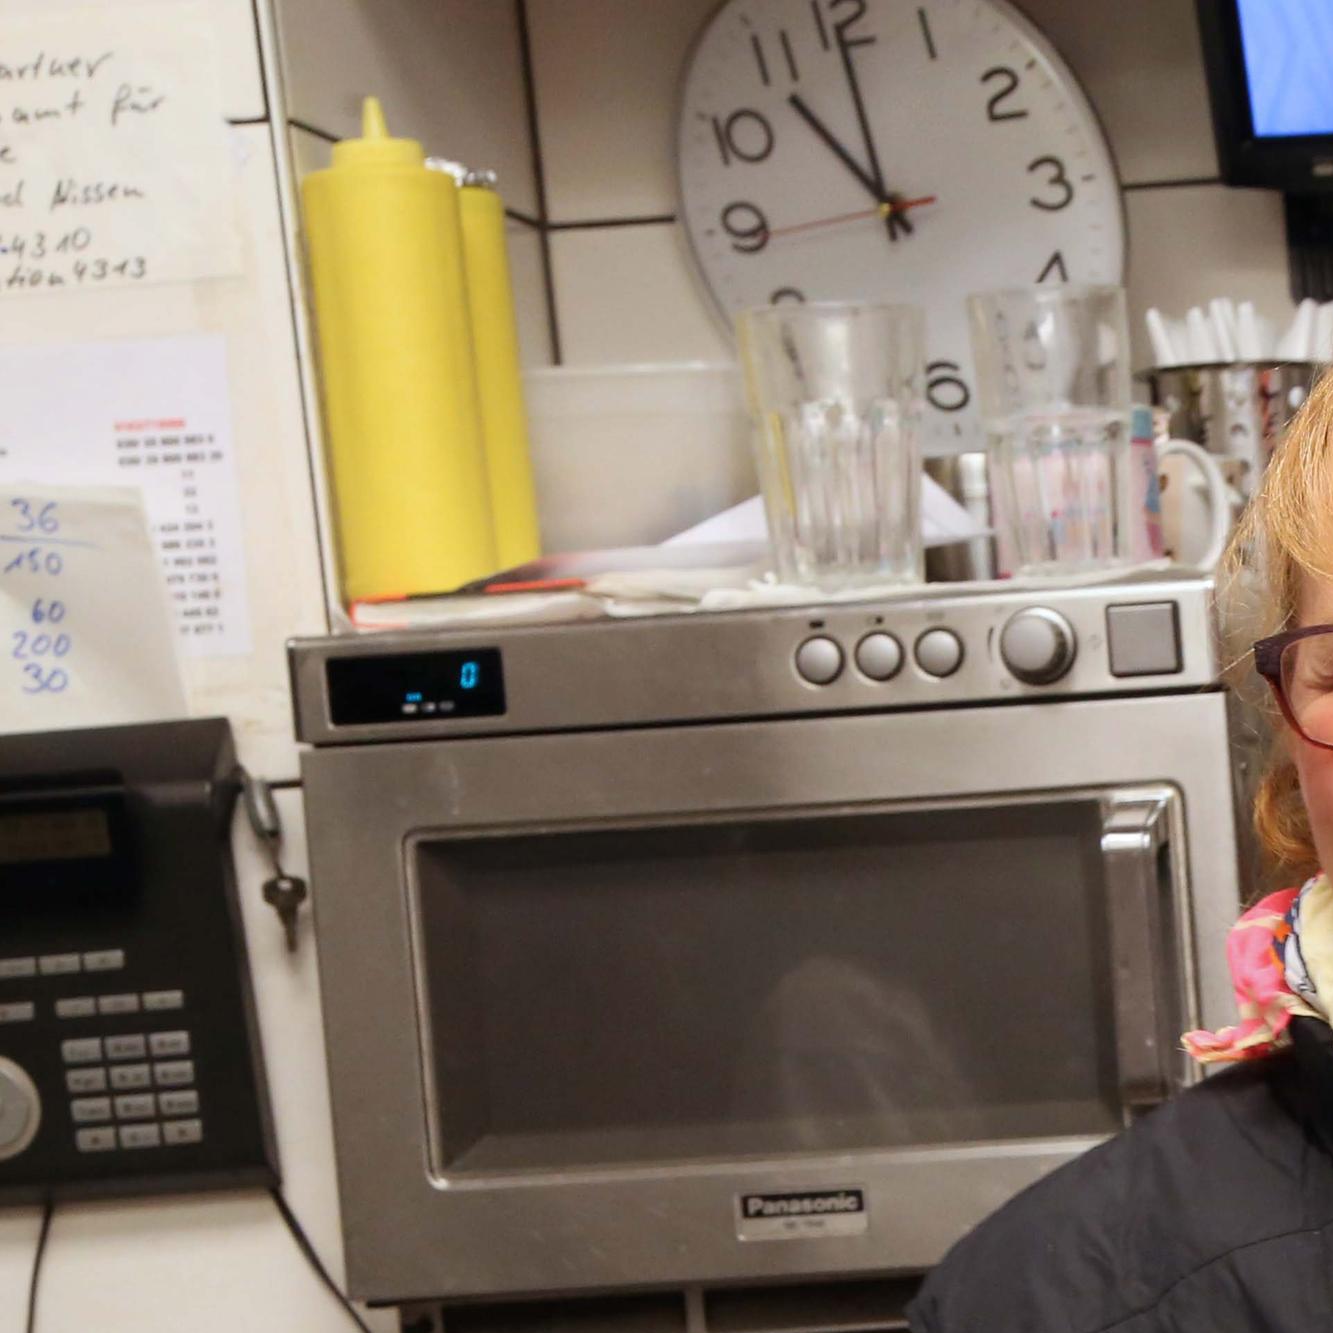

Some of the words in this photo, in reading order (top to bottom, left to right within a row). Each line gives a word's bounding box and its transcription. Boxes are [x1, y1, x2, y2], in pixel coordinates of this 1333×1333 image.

[751, 30, 799, 86] 11
[917, 7, 938, 60] 1
[979, 66, 1030, 123] 2
[711, 109, 775, 166] 10
[1025, 155, 1075, 212] 3
[720, 201, 769, 254] 9
[11, 498, 60, 533] 36
[31, 597, 66, 624] 60
[12, 629, 72, 659] 200
[21, 661, 69, 693] 30
[748, 1193, 858, 1215] Panasonic
